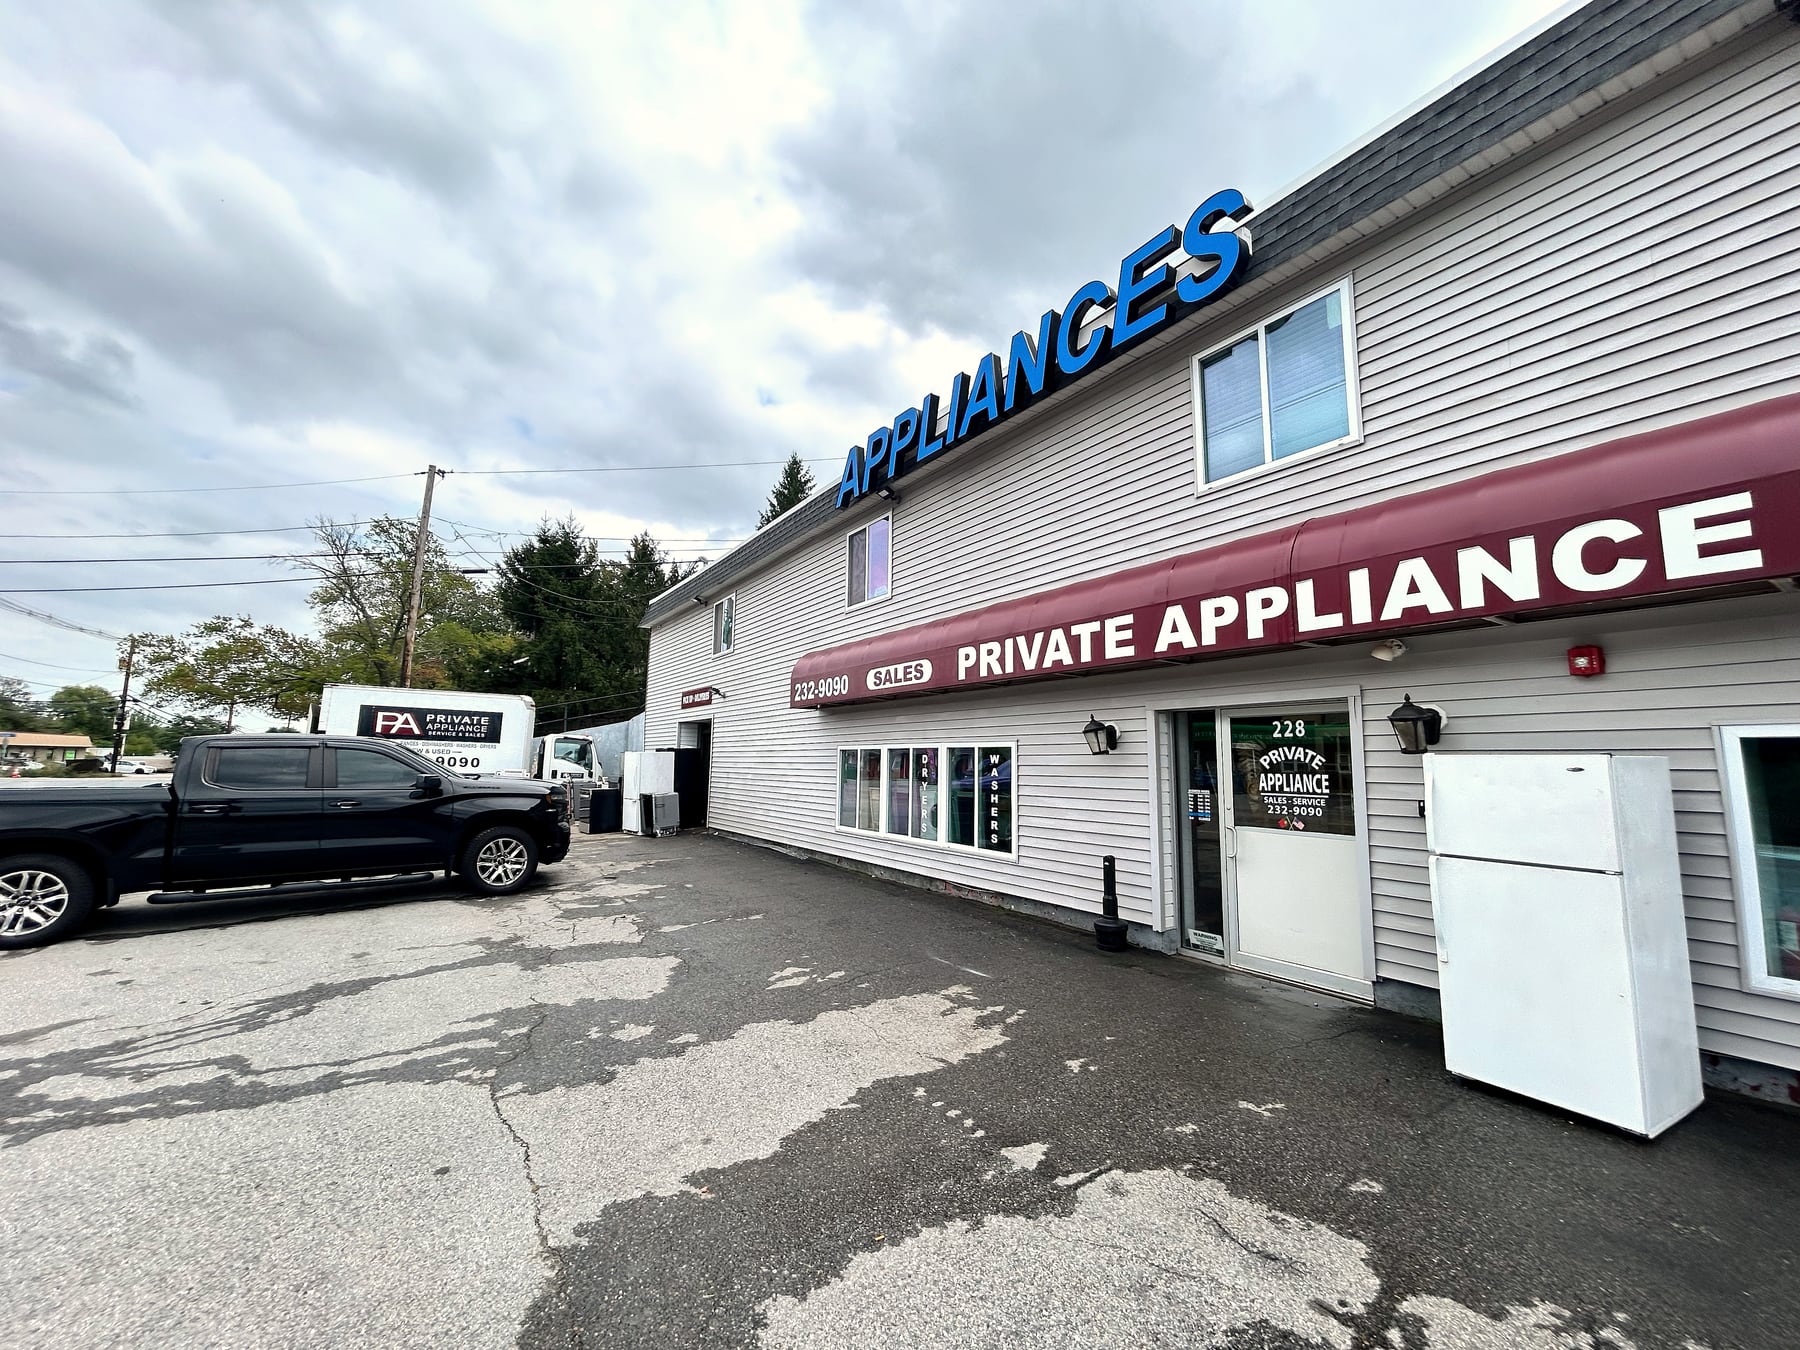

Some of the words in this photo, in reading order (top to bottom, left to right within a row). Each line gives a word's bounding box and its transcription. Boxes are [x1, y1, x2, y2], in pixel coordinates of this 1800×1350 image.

[836, 188, 1254, 510] APPLIANCES
[794, 674, 849, 702] 232-9090
[873, 663, 924, 687] SALES
[957, 613, 1135, 681] PRIVATE
[1153, 491, 1764, 653] APPLIANCE
[375, 711, 421, 735] PA
[425, 723, 488, 733] APPLIANCE
[426, 713, 490, 725] PRIVATE
[1272, 719, 1306, 738] 228
[436, 756, 480, 768] 9090
[1259, 746, 1327, 770] PRIVATE
[921, 754, 929, 833] DRYERS
[1258, 773, 1330, 794] APPLIANCE
[989, 754, 1000, 844] WASHERS
[1263, 796, 1287, 805] SALES
[1292, 797, 1326, 807] SERVICE
[1267, 804, 1323, 817] 232-9090
